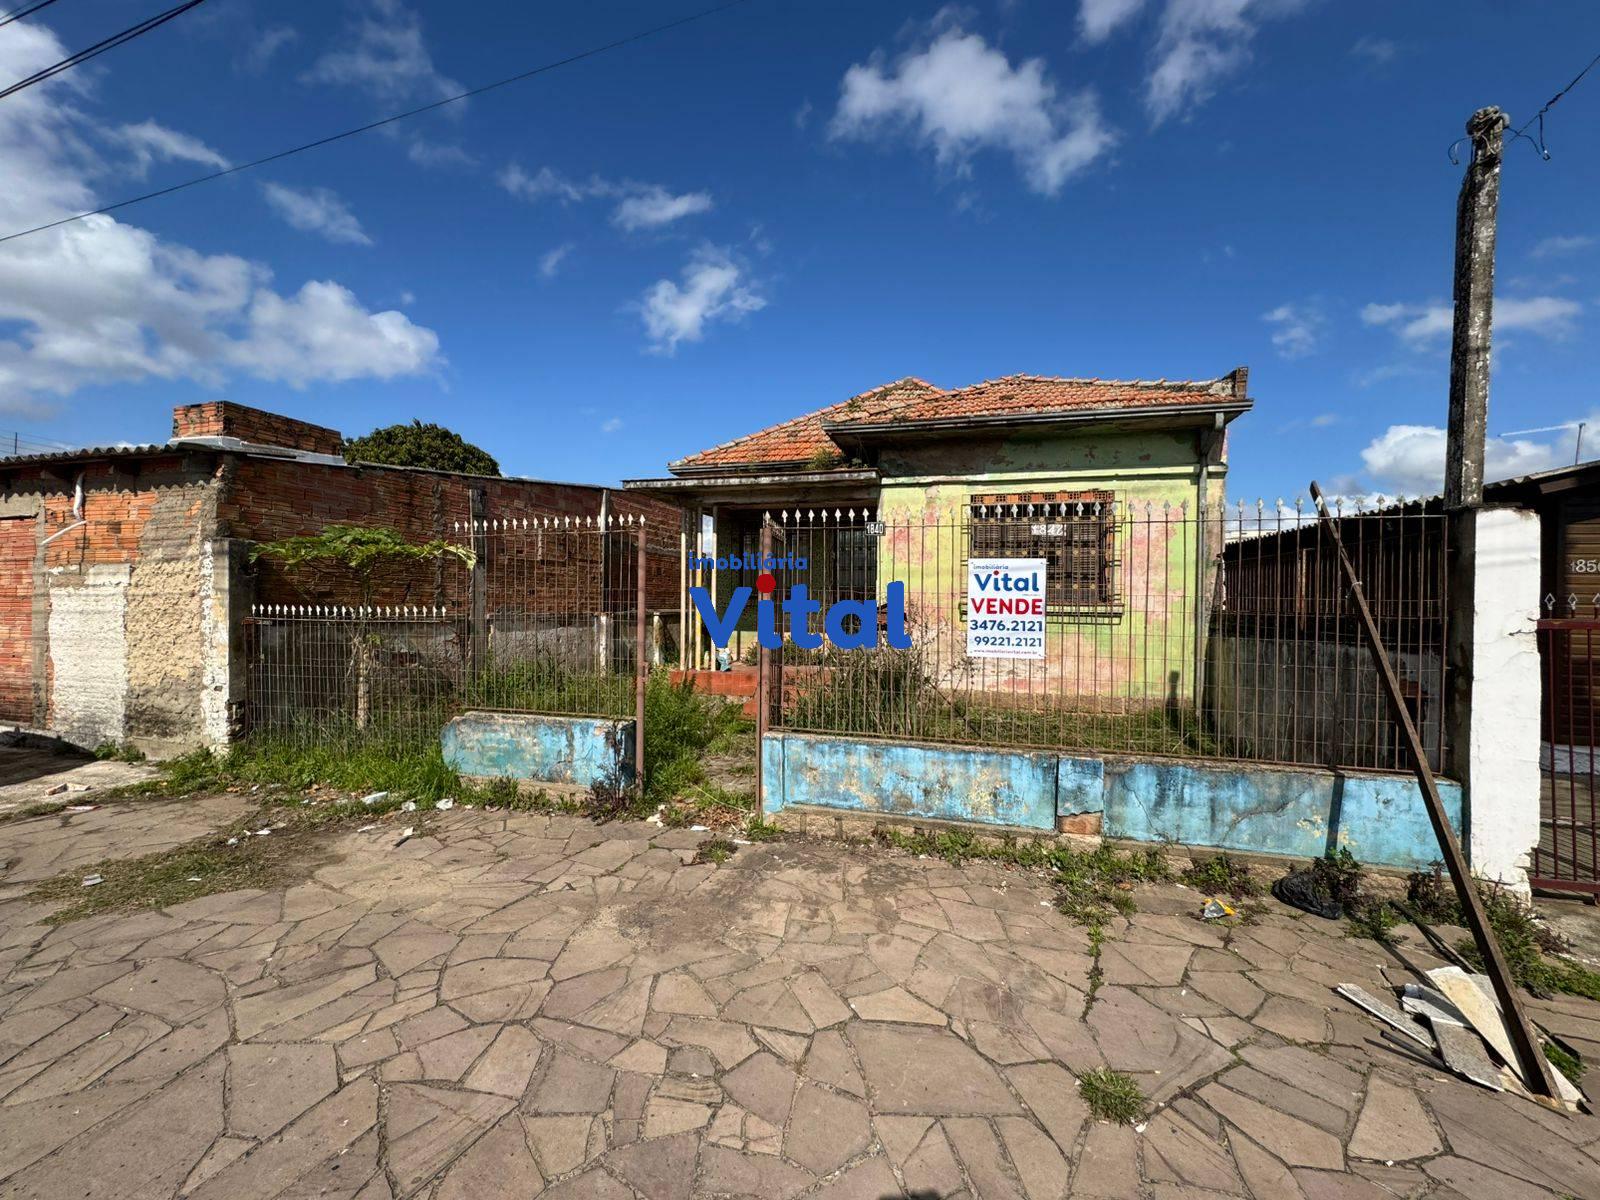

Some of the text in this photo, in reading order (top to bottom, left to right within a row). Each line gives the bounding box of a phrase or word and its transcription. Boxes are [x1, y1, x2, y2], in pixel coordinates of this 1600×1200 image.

[866, 523, 884, 534] 1840
[1570, 559, 1600, 573] 185
[973, 570, 1040, 592] Vital
[970, 598, 1043, 615] VENDE
[970, 619, 1043, 632] 3476.2121
[974, 636, 1042, 647] 99221.2121
